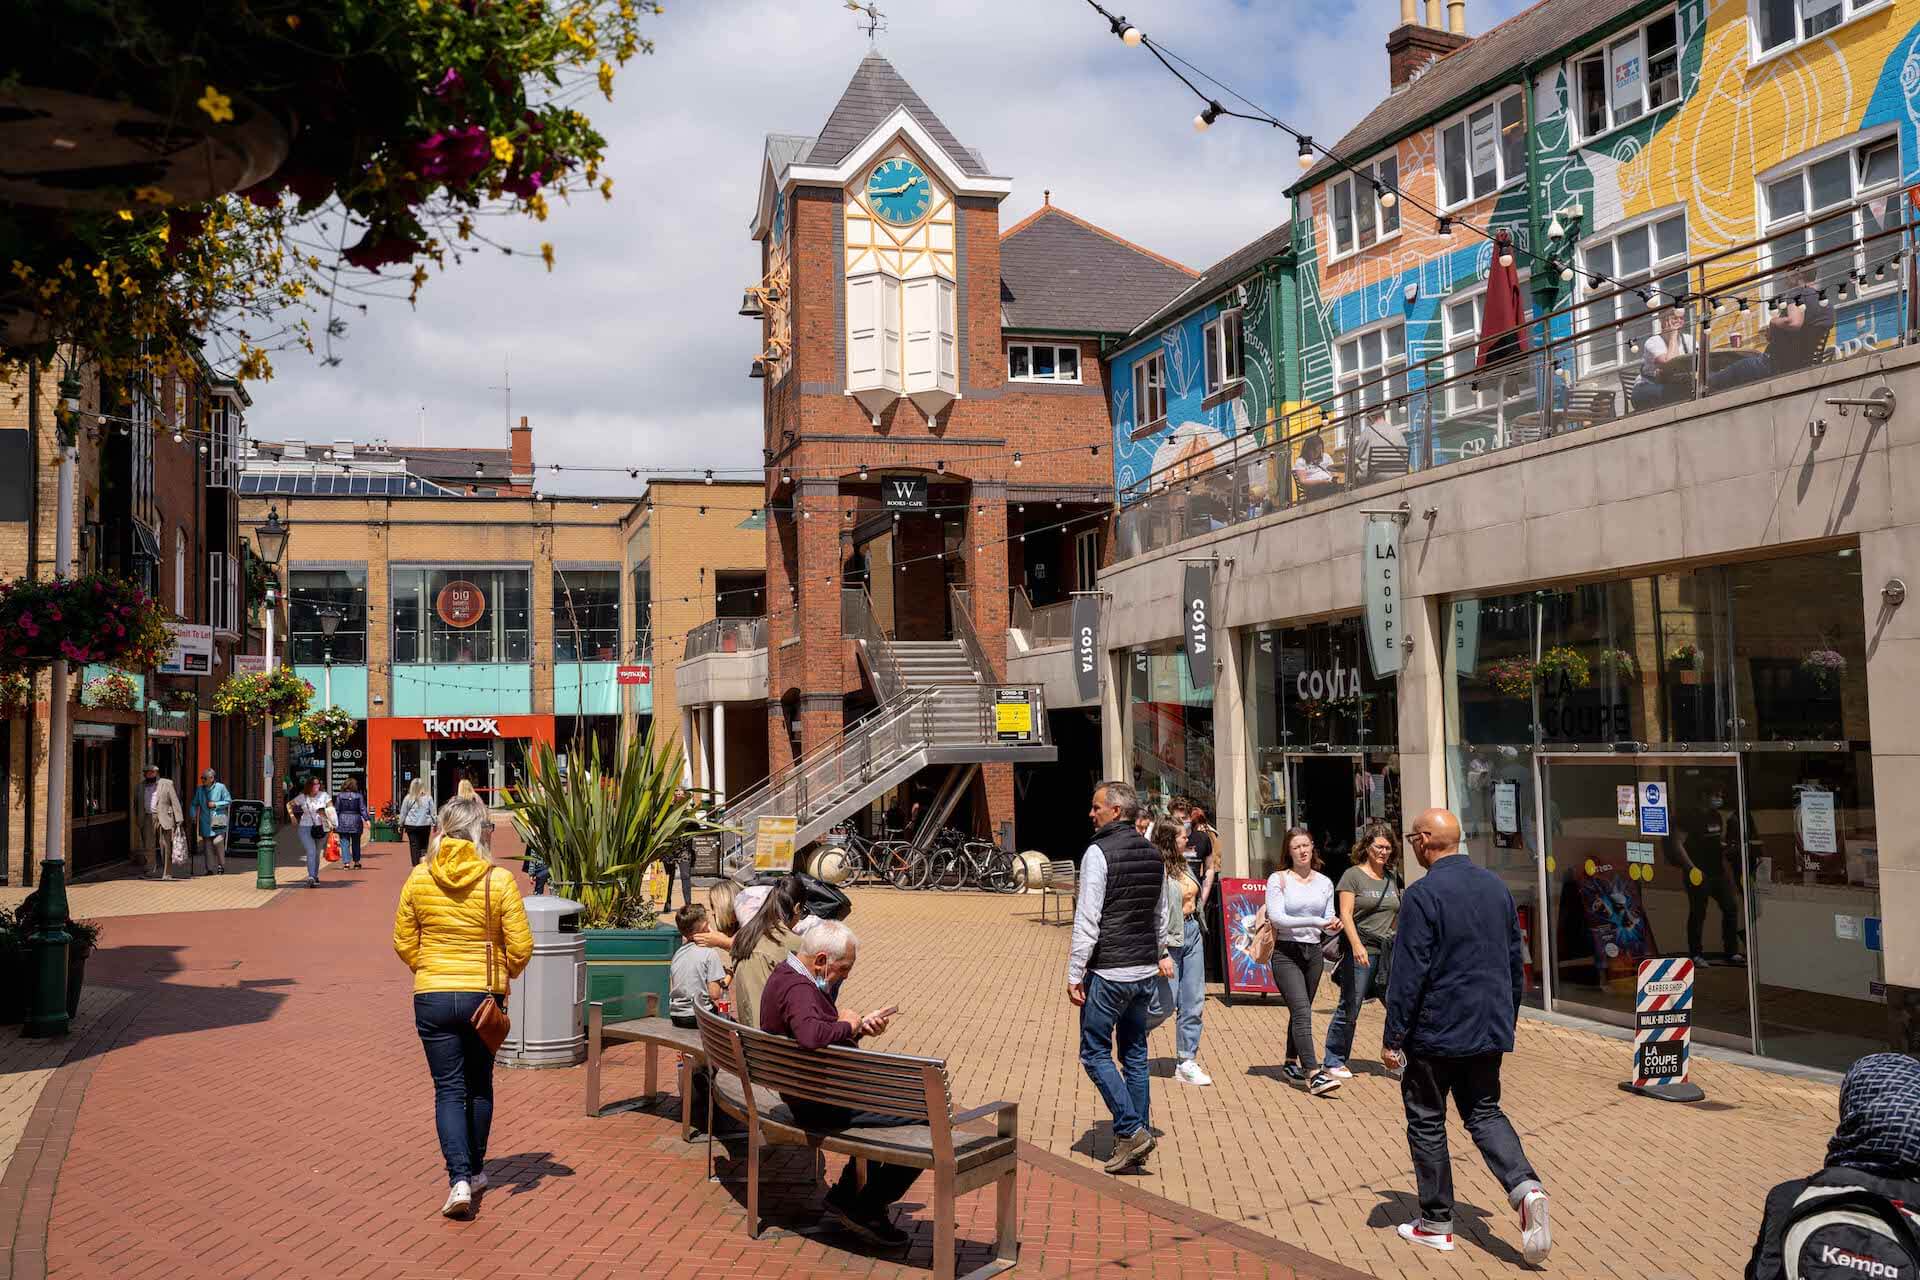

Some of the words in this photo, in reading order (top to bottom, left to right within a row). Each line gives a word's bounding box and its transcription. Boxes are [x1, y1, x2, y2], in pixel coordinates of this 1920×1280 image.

[893, 481, 916, 499] W
[1376, 544, 1396, 559] LA
[452, 589, 470, 601] big
[1383, 569, 1393, 649] COUPE
[1192, 598, 1207, 654] COSTA
[1081, 626, 1093, 673] COSTA
[1297, 667, 1362, 702] COSTA
[1242, 883, 1267, 891] COSTA
[1648, 985, 1669, 993] BARBER
[1670, 983, 1683, 991] SHOP
[1640, 1014, 1664, 1026] WALK-IN
[1664, 1013, 1687, 1025] SERVICE
[1645, 1045, 1658, 1057] LA
[1644, 1054, 1678, 1067] COUPE
[1643, 1066, 1678, 1076] STUDIO
[1821, 1244, 1899, 1279] Kempa
